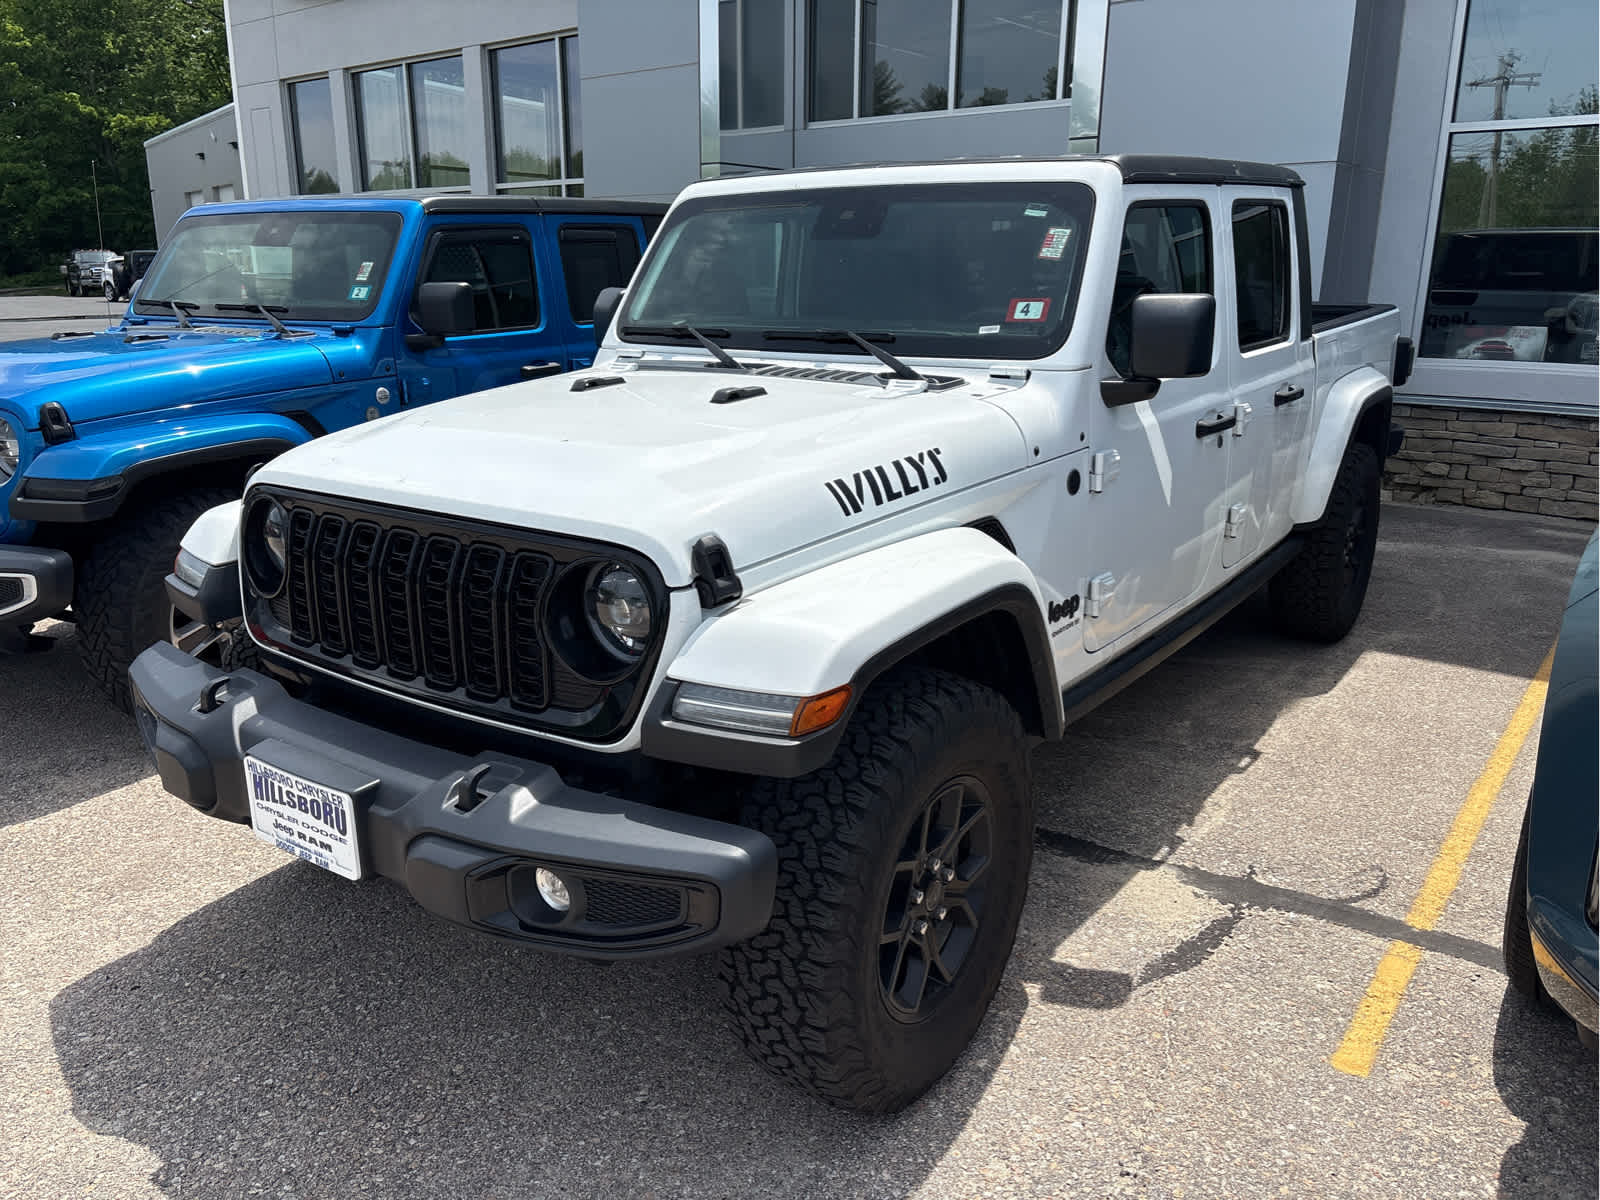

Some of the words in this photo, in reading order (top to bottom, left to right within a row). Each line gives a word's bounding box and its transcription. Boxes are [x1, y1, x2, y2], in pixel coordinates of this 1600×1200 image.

[1020, 302, 1031, 316] 4
[824, 447, 948, 517] WILLYS
[246, 759, 294, 789] HILLSBORO
[295, 780, 344, 809] CHRYSLER
[256, 802, 299, 826] CHRYSLER
[301, 821, 349, 846] DODGE
[272, 818, 294, 837] Jeep
[297, 830, 333, 853] RAM
